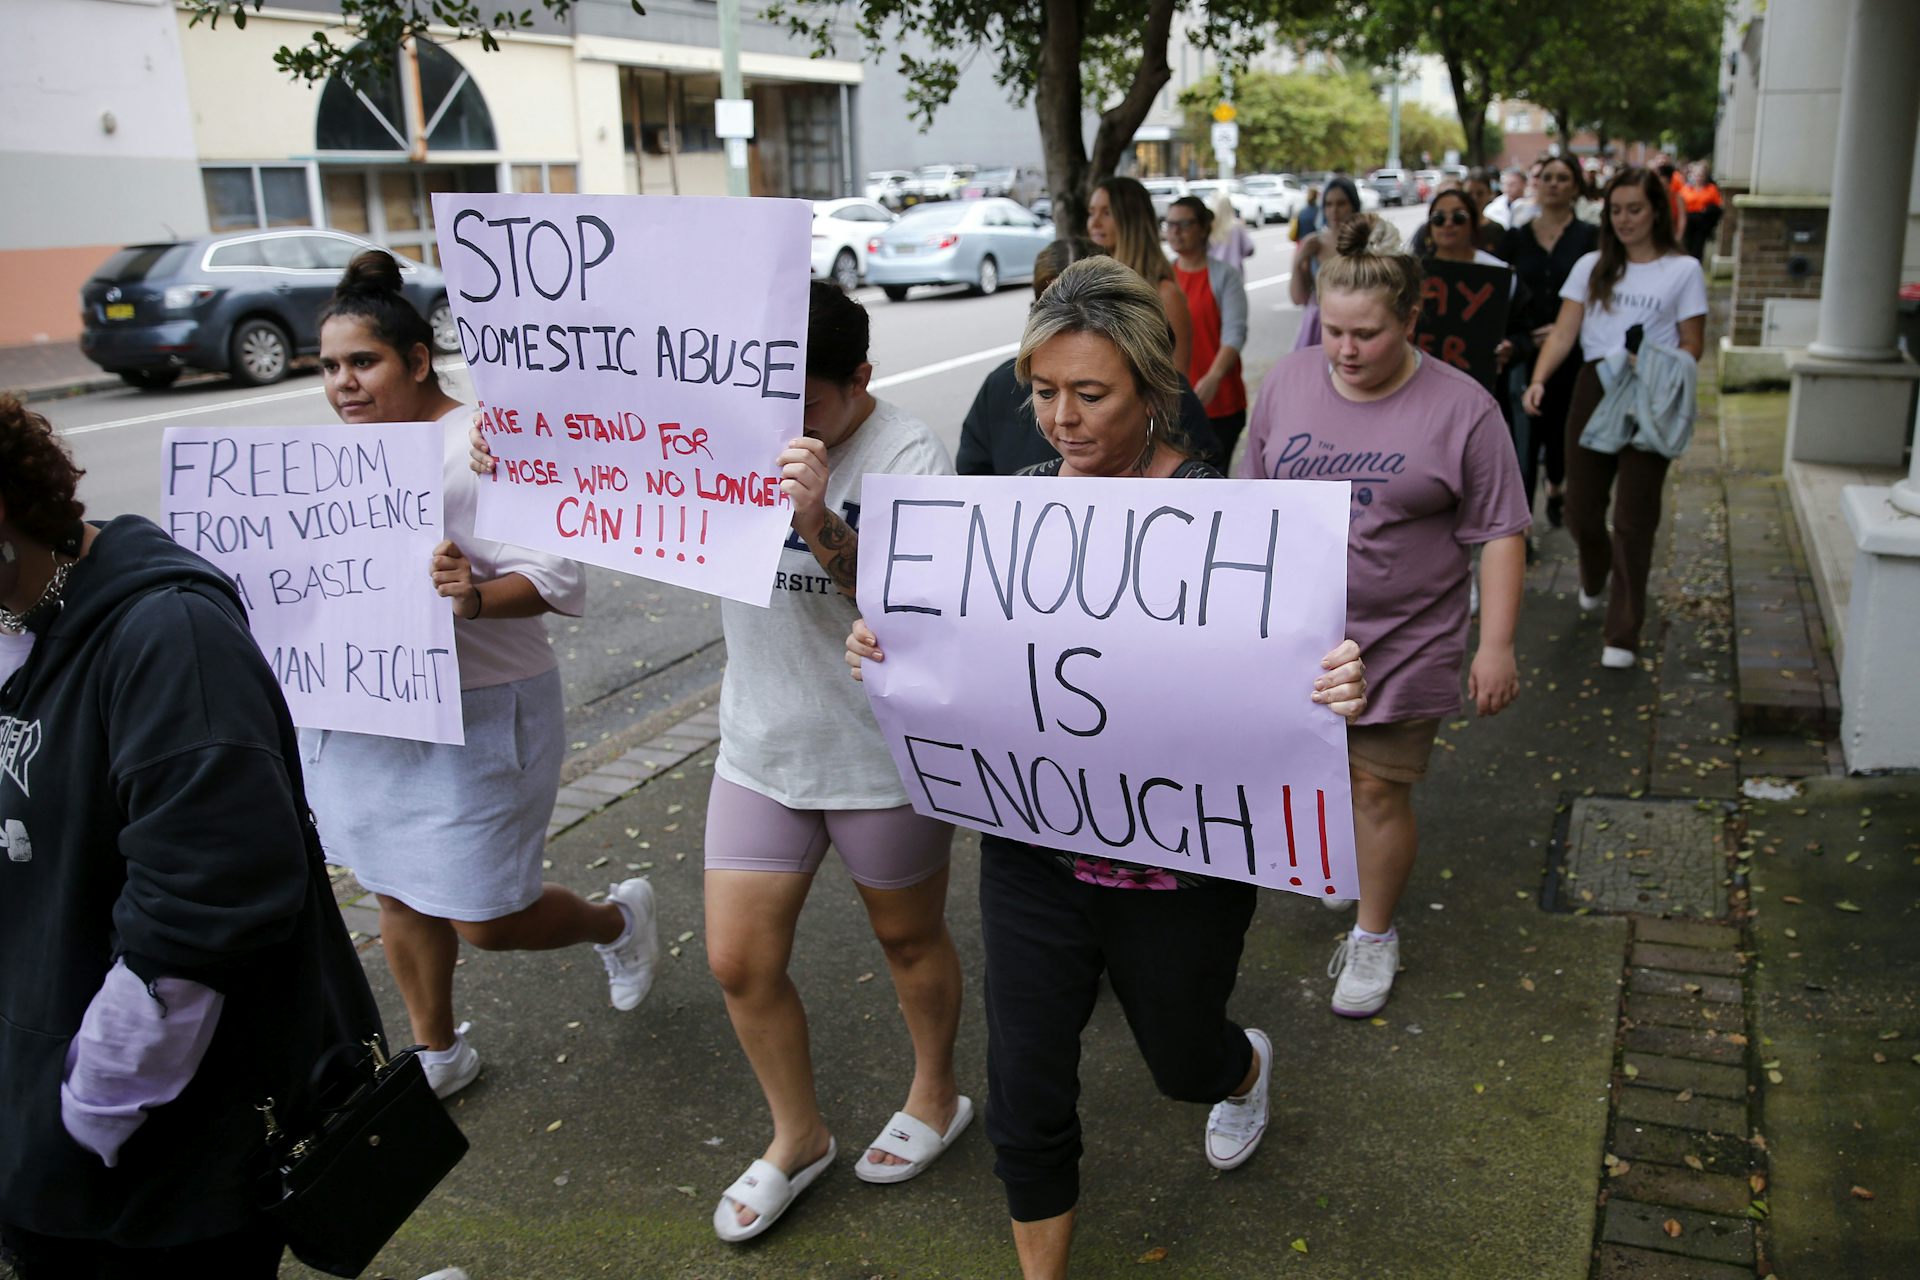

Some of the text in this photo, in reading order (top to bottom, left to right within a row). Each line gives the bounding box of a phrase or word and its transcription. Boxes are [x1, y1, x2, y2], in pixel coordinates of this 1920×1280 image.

[453, 208, 615, 302] STOP
[457, 316, 801, 399] DOMESTIC ABUSE
[536, 412, 552, 437] A
[564, 412, 646, 443] STAND
[658, 422, 714, 460] FOR
[1274, 432, 1406, 479] Panama
[1318, 440, 1335, 451] THE
[168, 437, 392, 497] FREEDOM
[574, 465, 628, 495] WHO
[646, 469, 685, 497] NO
[168, 488, 434, 553] FROM VIOLENCE
[269, 558, 386, 605] BASIC
[775, 571, 841, 595] RSIT
[884, 499, 1279, 639] ENOUGH
[346, 642, 449, 703] RIGHT
[1027, 642, 1107, 737] IS
